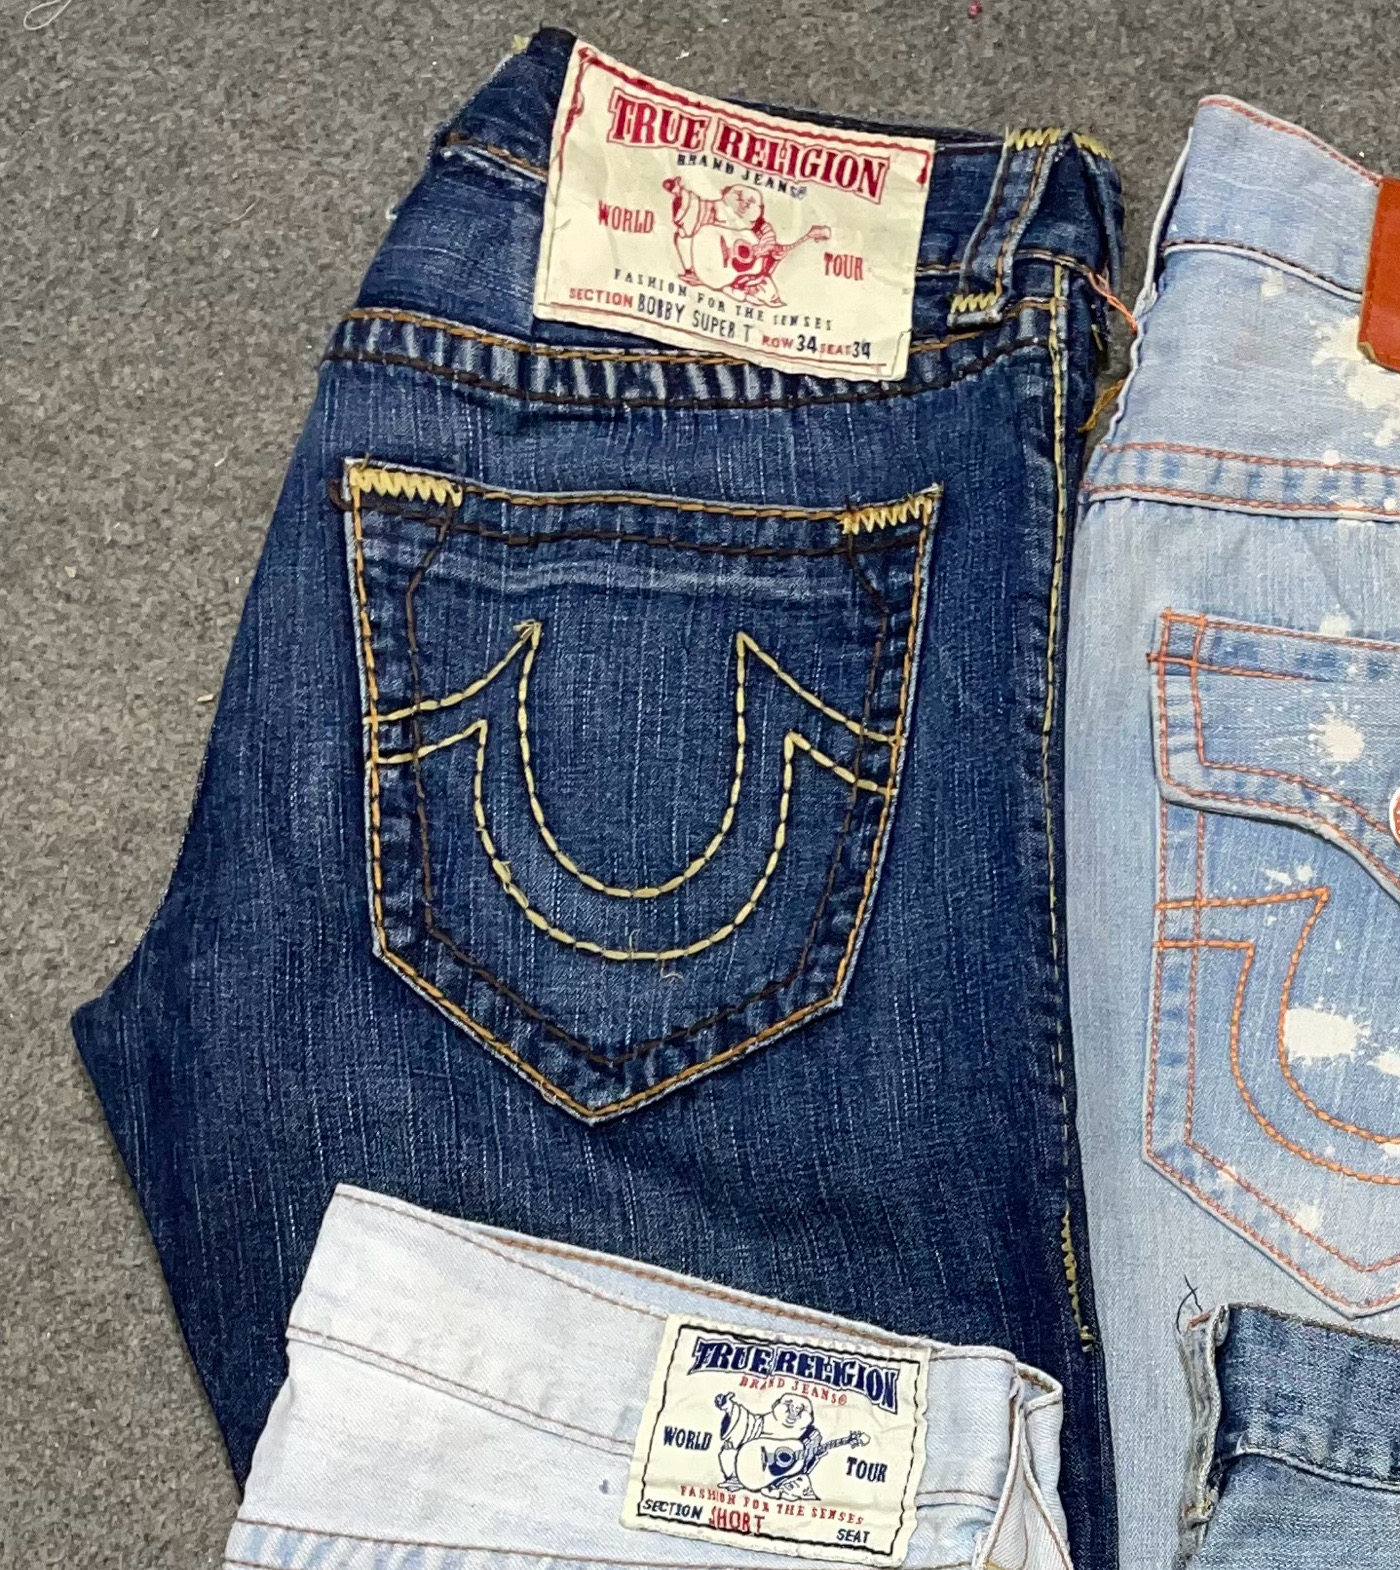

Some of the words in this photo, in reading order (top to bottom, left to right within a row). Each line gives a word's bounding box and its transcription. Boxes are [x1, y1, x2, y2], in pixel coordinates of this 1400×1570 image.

[607, 88, 706, 152] TRUE
[715, 117, 888, 202] RELIGION
[676, 153, 735, 175] BRAND
[598, 199, 655, 233] WORLD
[823, 251, 864, 281] TOUR
[614, 268, 687, 297] FASHION
[698, 293, 725, 313] FOR
[736, 305, 764, 321] THE
[773, 315, 833, 331] SENSES
[569, 288, 633, 308] SECTION
[637, 293, 685, 323] BOBBY
[692, 310, 736, 338] SUPER
[743, 324, 755, 342] T
[762, 334, 795, 350] ROW
[796, 334, 817, 354] 34
[820, 343, 851, 356] SEAT
[690, 1338, 771, 1374] TRUE
[774, 1347, 899, 1412] RELIGION
[739, 1376, 786, 1390] BRAND
[663, 1426, 713, 1451] WORLD
[846, 1456, 888, 1483] TOUR
[643, 1499, 704, 1520] SECTION
[708, 1505, 765, 1535] SHORT
[836, 1528, 871, 1544] SEAT
[680, 1484, 735, 1506] FASHION
[743, 1496, 770, 1513] FOR
[776, 1503, 805, 1516] THE
[811, 1508, 865, 1526] SENSES
